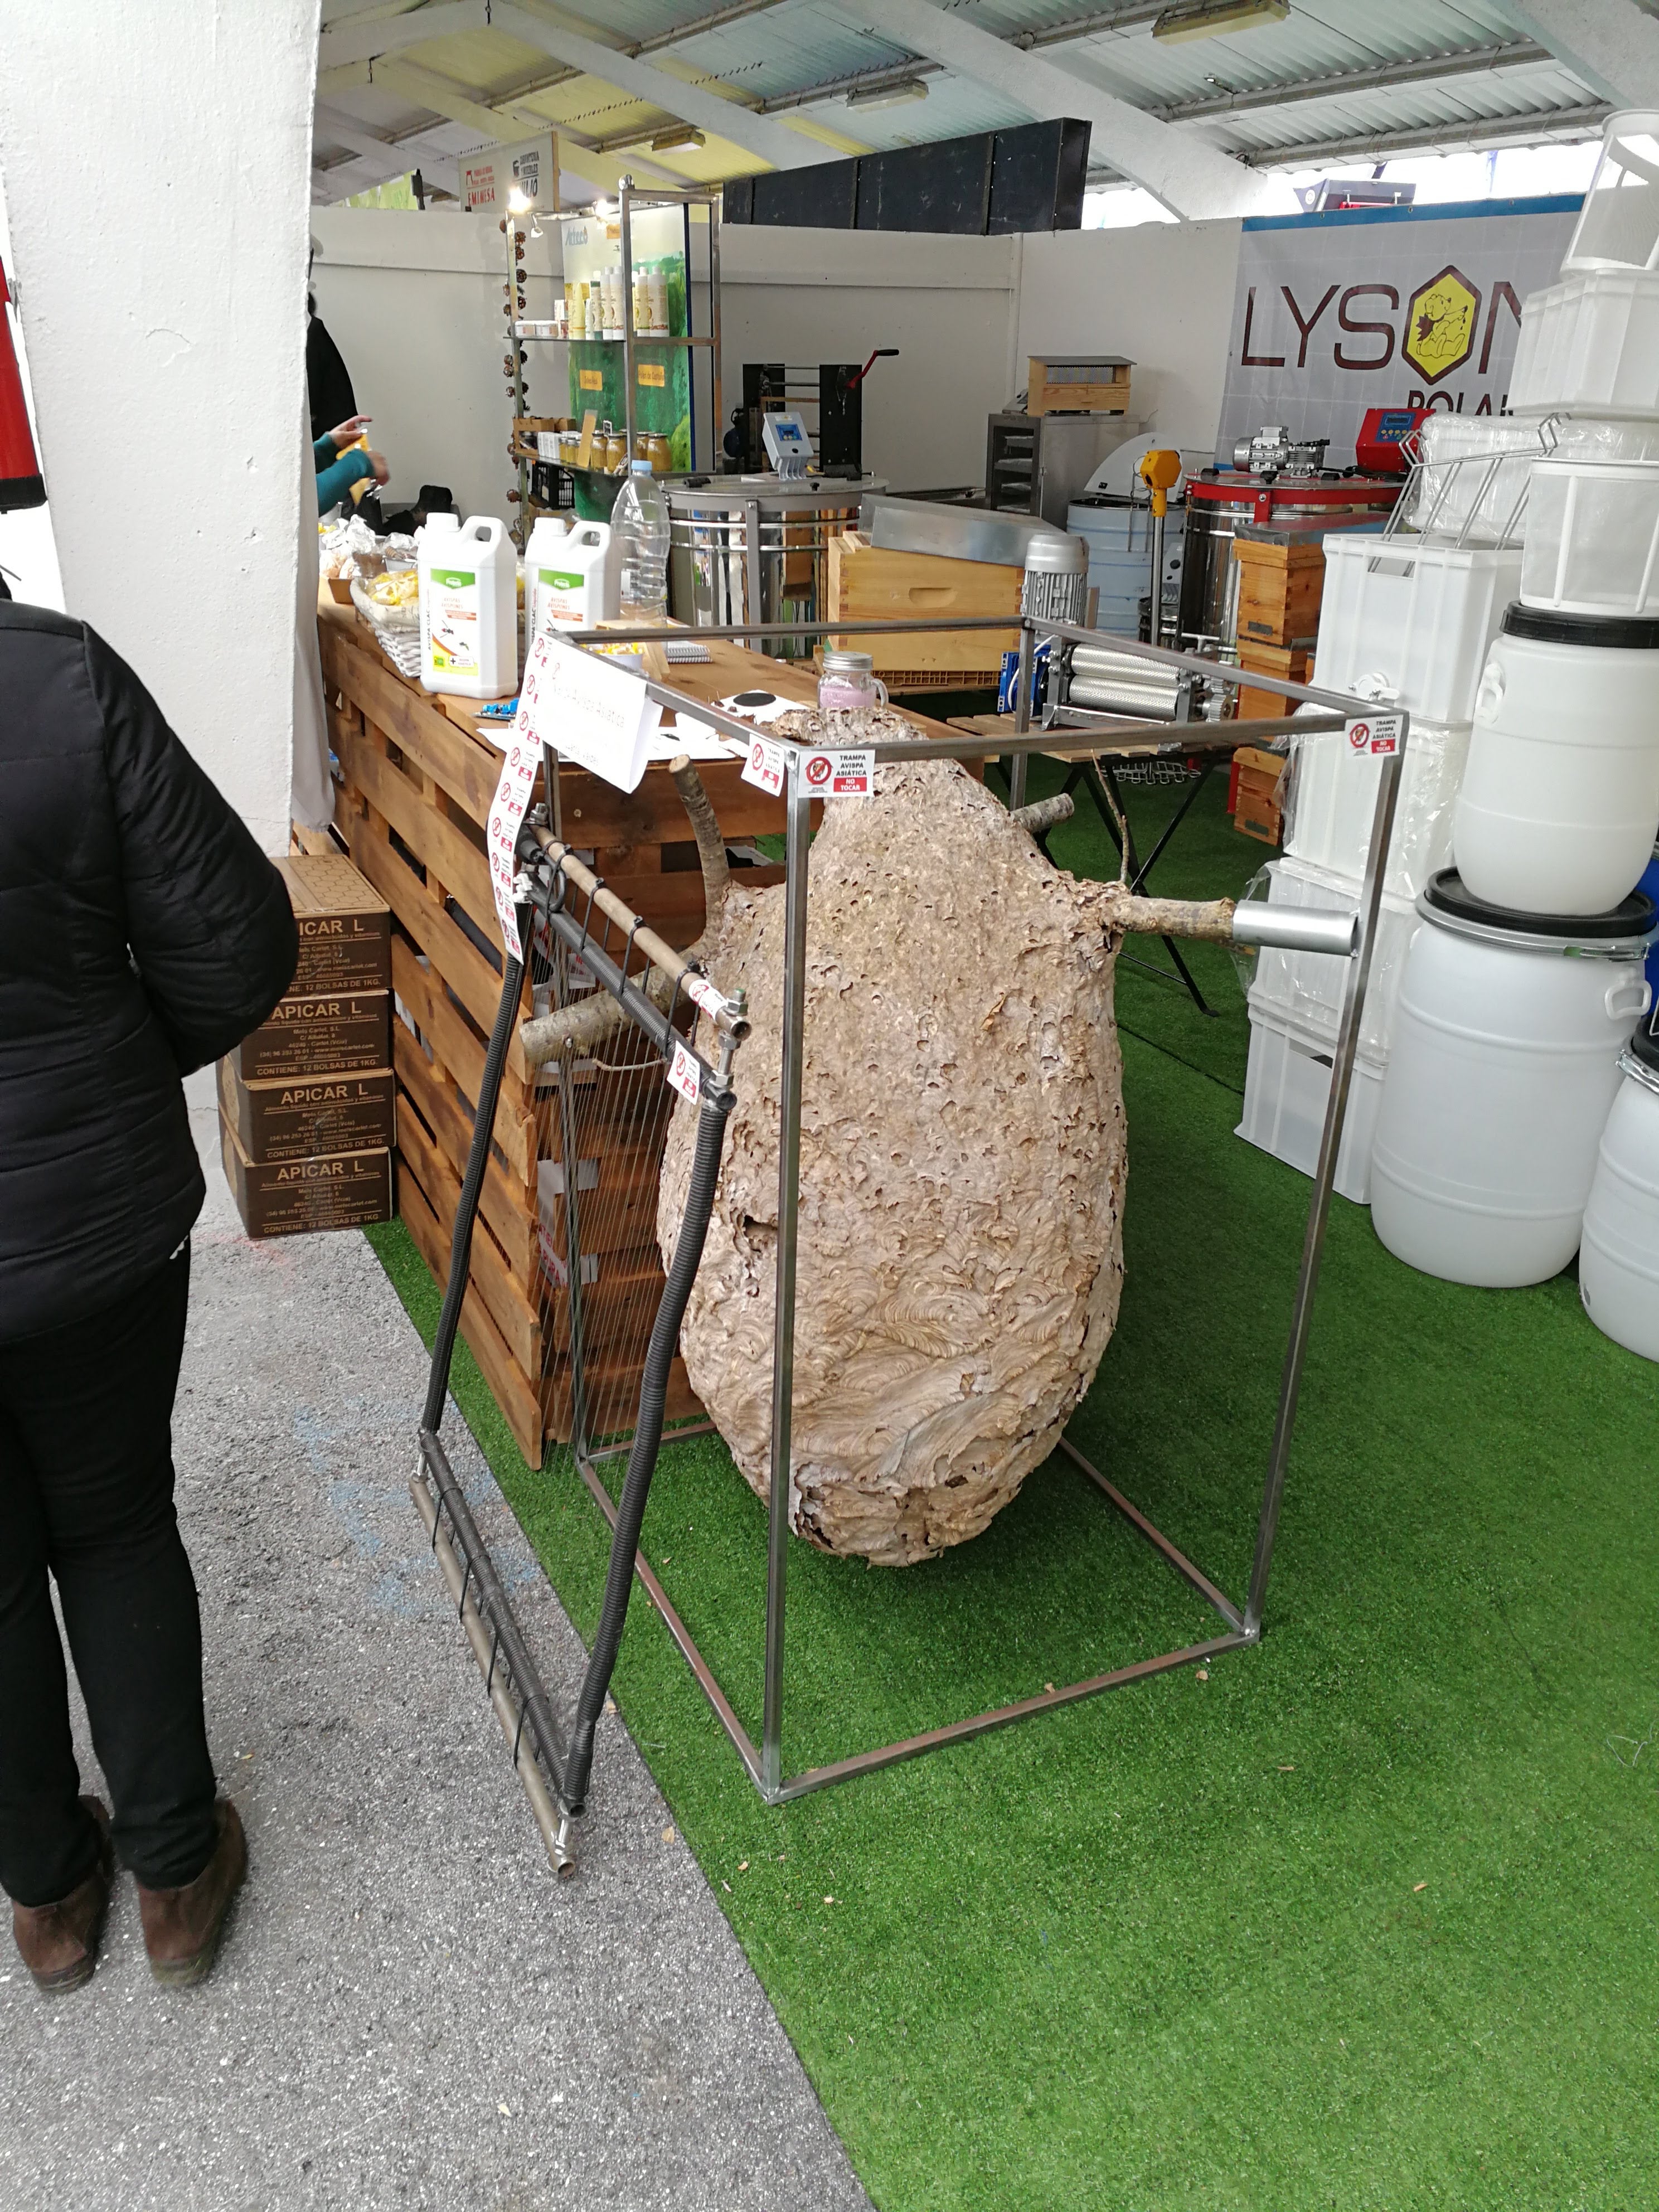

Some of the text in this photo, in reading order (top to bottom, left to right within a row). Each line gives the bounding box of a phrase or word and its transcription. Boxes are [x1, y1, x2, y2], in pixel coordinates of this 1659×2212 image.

[299, 919, 364, 936] ICAR L
[316, 981, 348, 990] BOLSAS
[271, 1001, 362, 1020] APICAR L
[257, 1066, 300, 1076] CONTIENE:
[314, 1061, 345, 1070] BOLSAS
[281, 1083, 368, 1104] APICAR L
[267, 1148, 309, 1158] CONTIENE:
[322, 1142, 353, 1152] BOLSAS
[276, 1160, 364, 1181] APICAR L
[264, 1223, 305, 1234] CONTIENE:
[318, 1217, 349, 1227] BOLSAS
